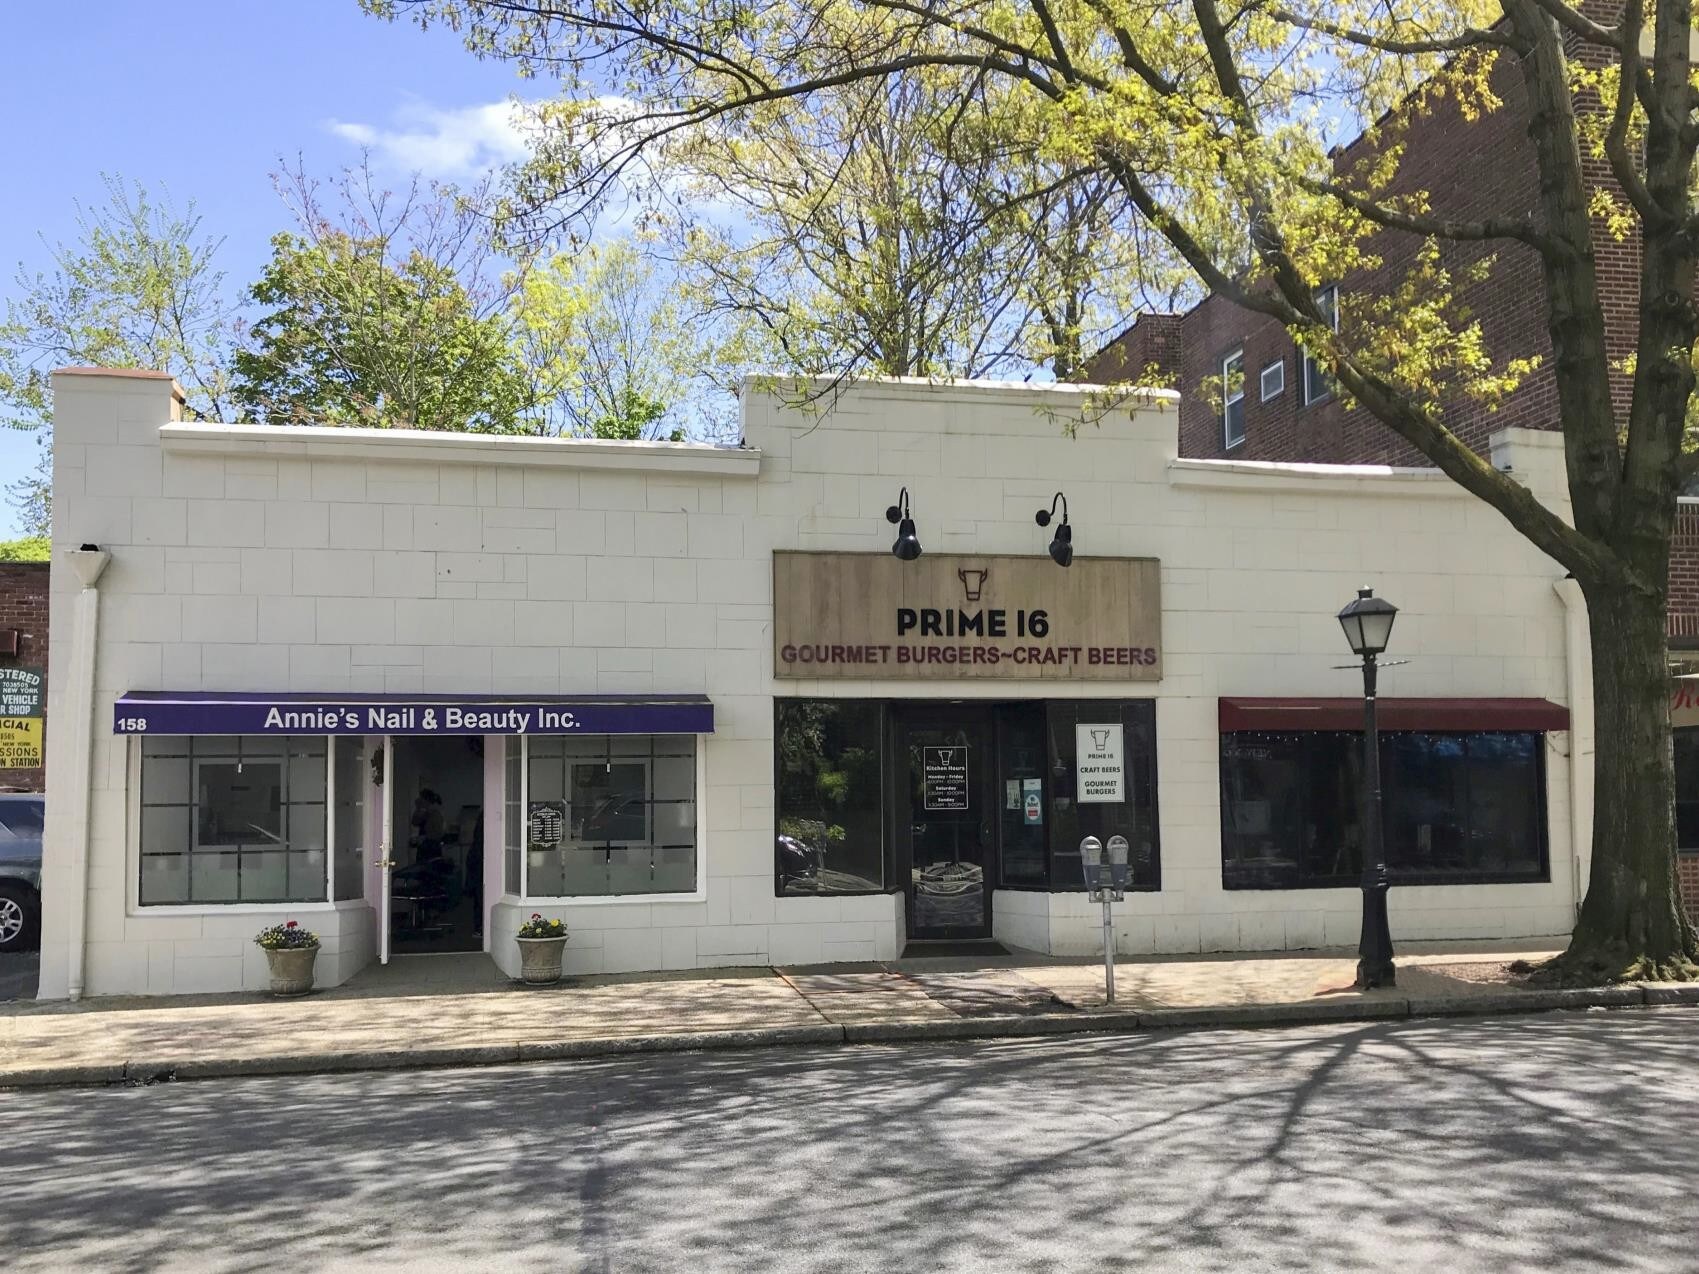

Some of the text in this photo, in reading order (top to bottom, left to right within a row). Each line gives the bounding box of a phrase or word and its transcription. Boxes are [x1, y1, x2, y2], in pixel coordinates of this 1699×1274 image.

[897, 609, 1049, 637] PRIME 16
[781, 645, 891, 663] GOURMET
[1088, 647, 1157, 665] BEERS
[2, 695, 38, 705] VEHICLE
[8, 705, 31, 715] SHOP
[117, 718, 147, 731] 158
[264, 707, 581, 733] Annie's Nail & Beauty Inc.
[11, 757, 39, 767] STATION
